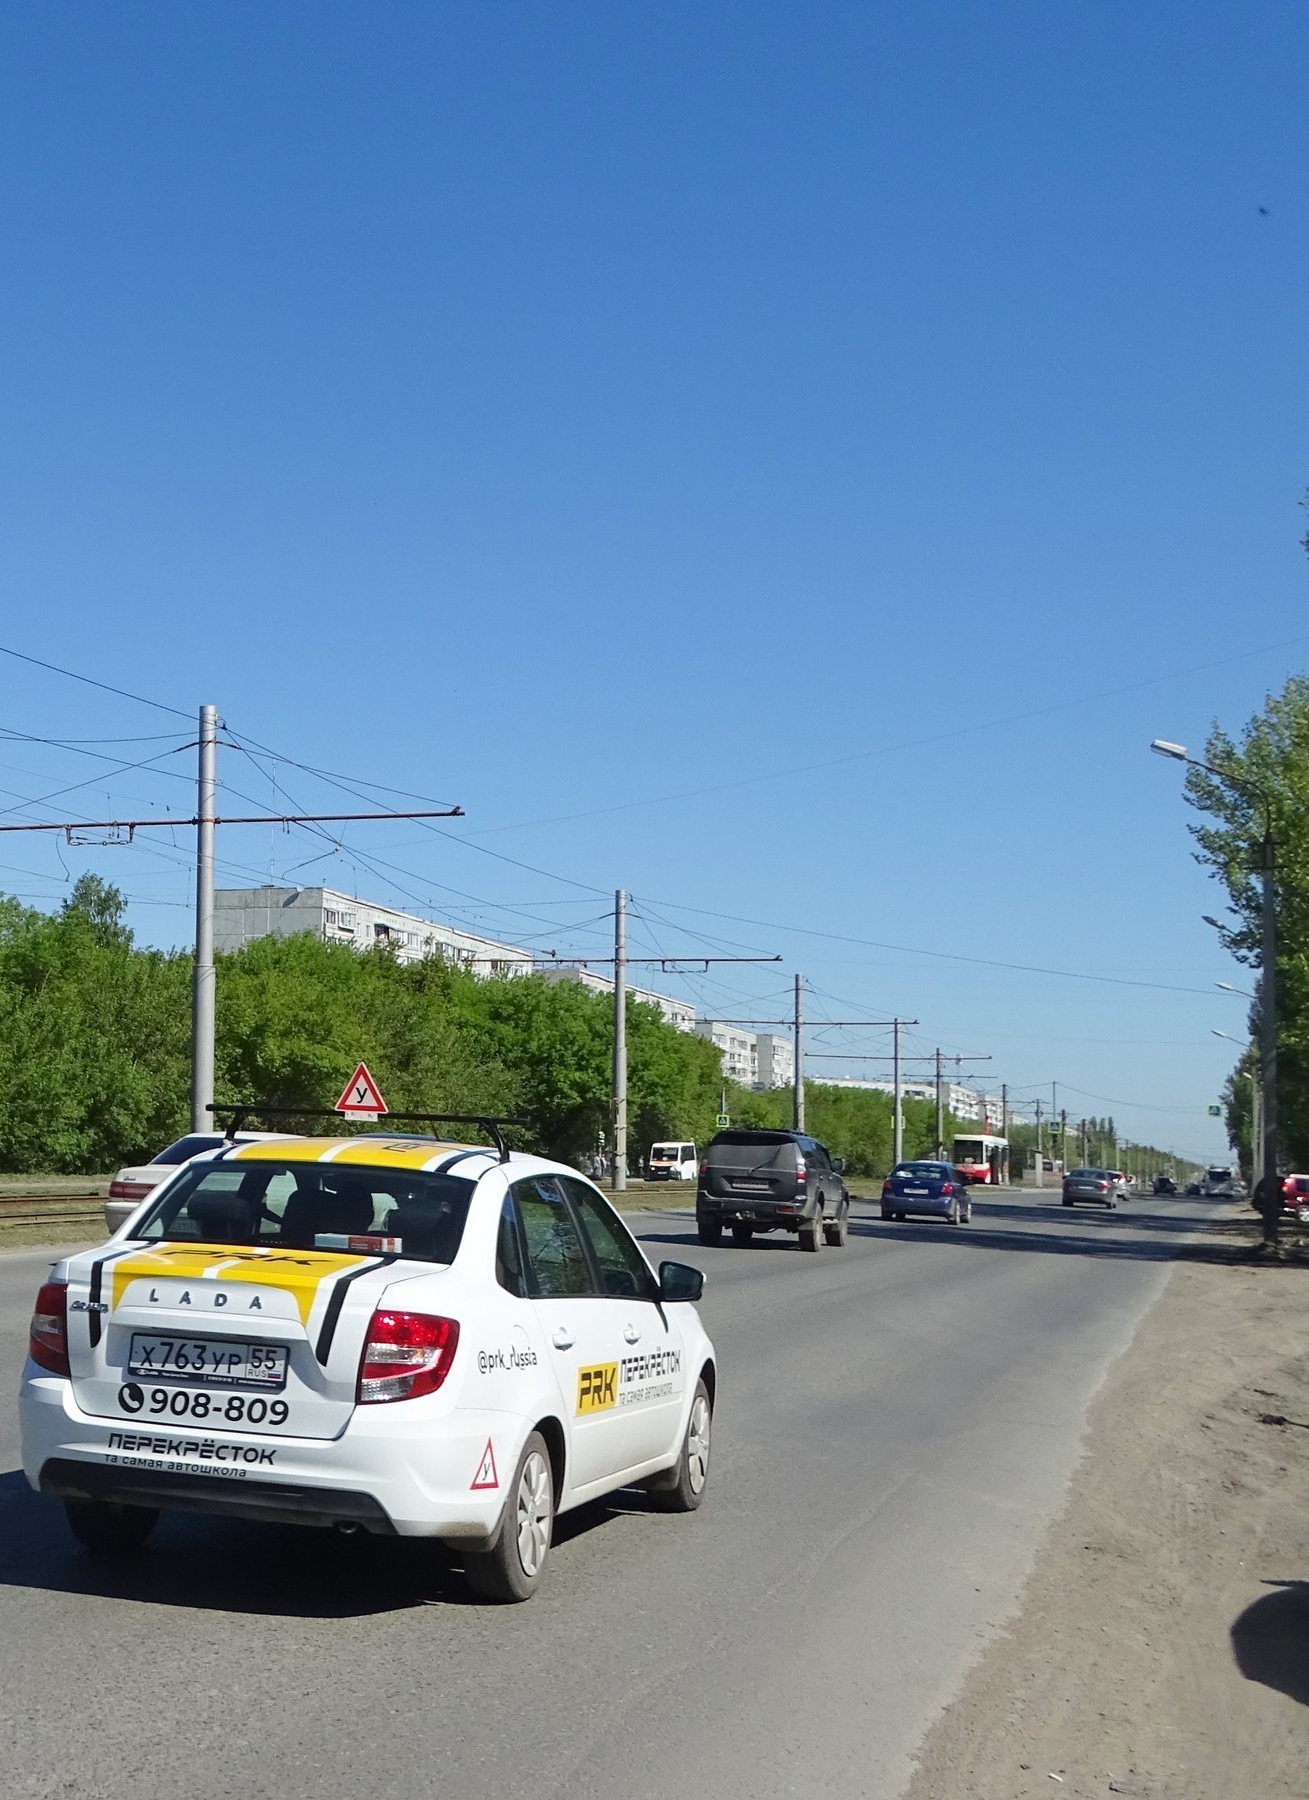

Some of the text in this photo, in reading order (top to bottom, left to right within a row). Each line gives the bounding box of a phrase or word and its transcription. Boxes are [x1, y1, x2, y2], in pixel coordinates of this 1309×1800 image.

[163, 1249, 333, 1266] PRK
[149, 1288, 262, 1310] LADA
[251, 1348, 277, 1369] 55
[477, 1346, 538, 1374] @prk_russia
[620, 1347, 681, 1384] ПЕРЕКРЁСТОК
[247, 1368, 267, 1378] RUS
[579, 1368, 617, 1409] PRK
[150, 1388, 290, 1426] 908-809
[108, 1433, 278, 1465] ПЕРЕКРЁСТОК
[104, 1454, 247, 1477] та самая автошкола
